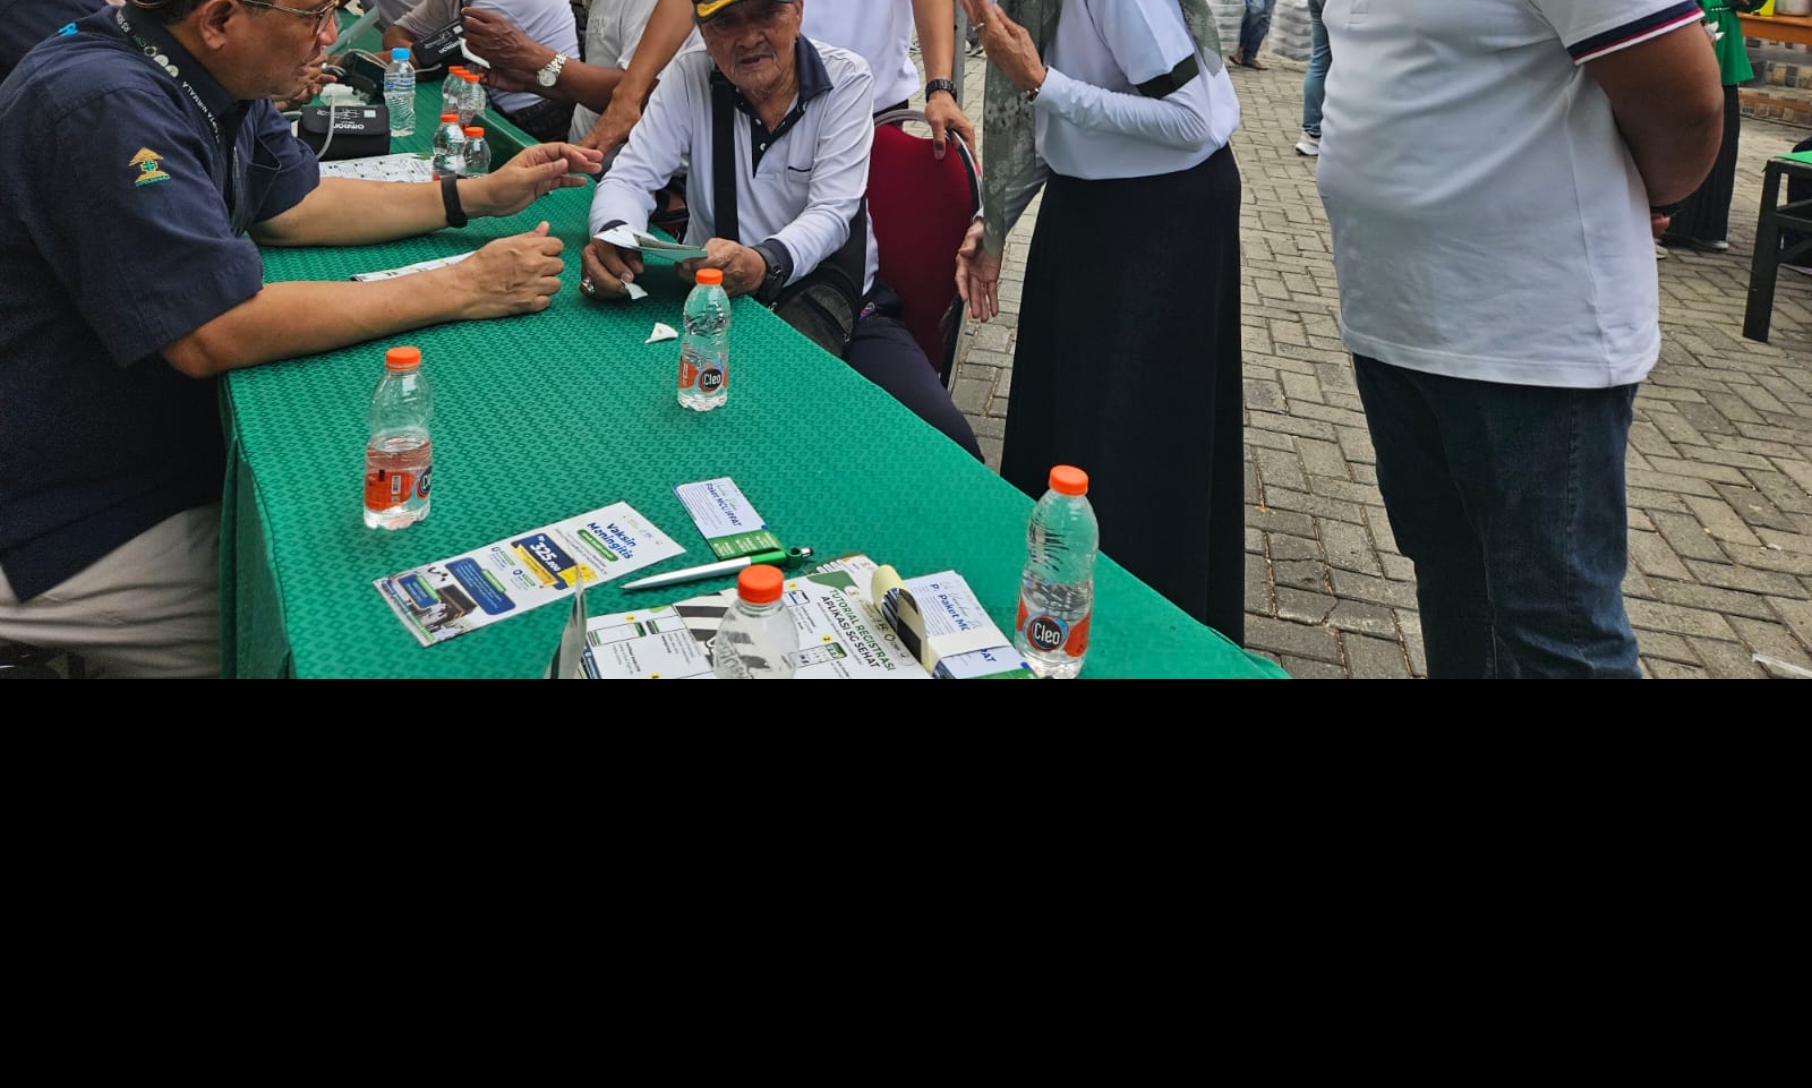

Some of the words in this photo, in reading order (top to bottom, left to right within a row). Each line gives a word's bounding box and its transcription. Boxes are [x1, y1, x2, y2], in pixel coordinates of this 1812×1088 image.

[704, 373, 721, 386] Cleo
[706, 483, 720, 499] Paket
[587, 522, 634, 560] Meningitis
[606, 523, 636, 548] Vaksin
[938, 594, 959, 620] Paket
[820, 596, 851, 633] APLIKASI
[845, 630, 857, 642] SG
[854, 639, 881, 669] SEHAT
[829, 589, 859, 627] TUTORIAL
[856, 623, 896, 671] REGISTRASI
[1032, 621, 1061, 645] Cleo
